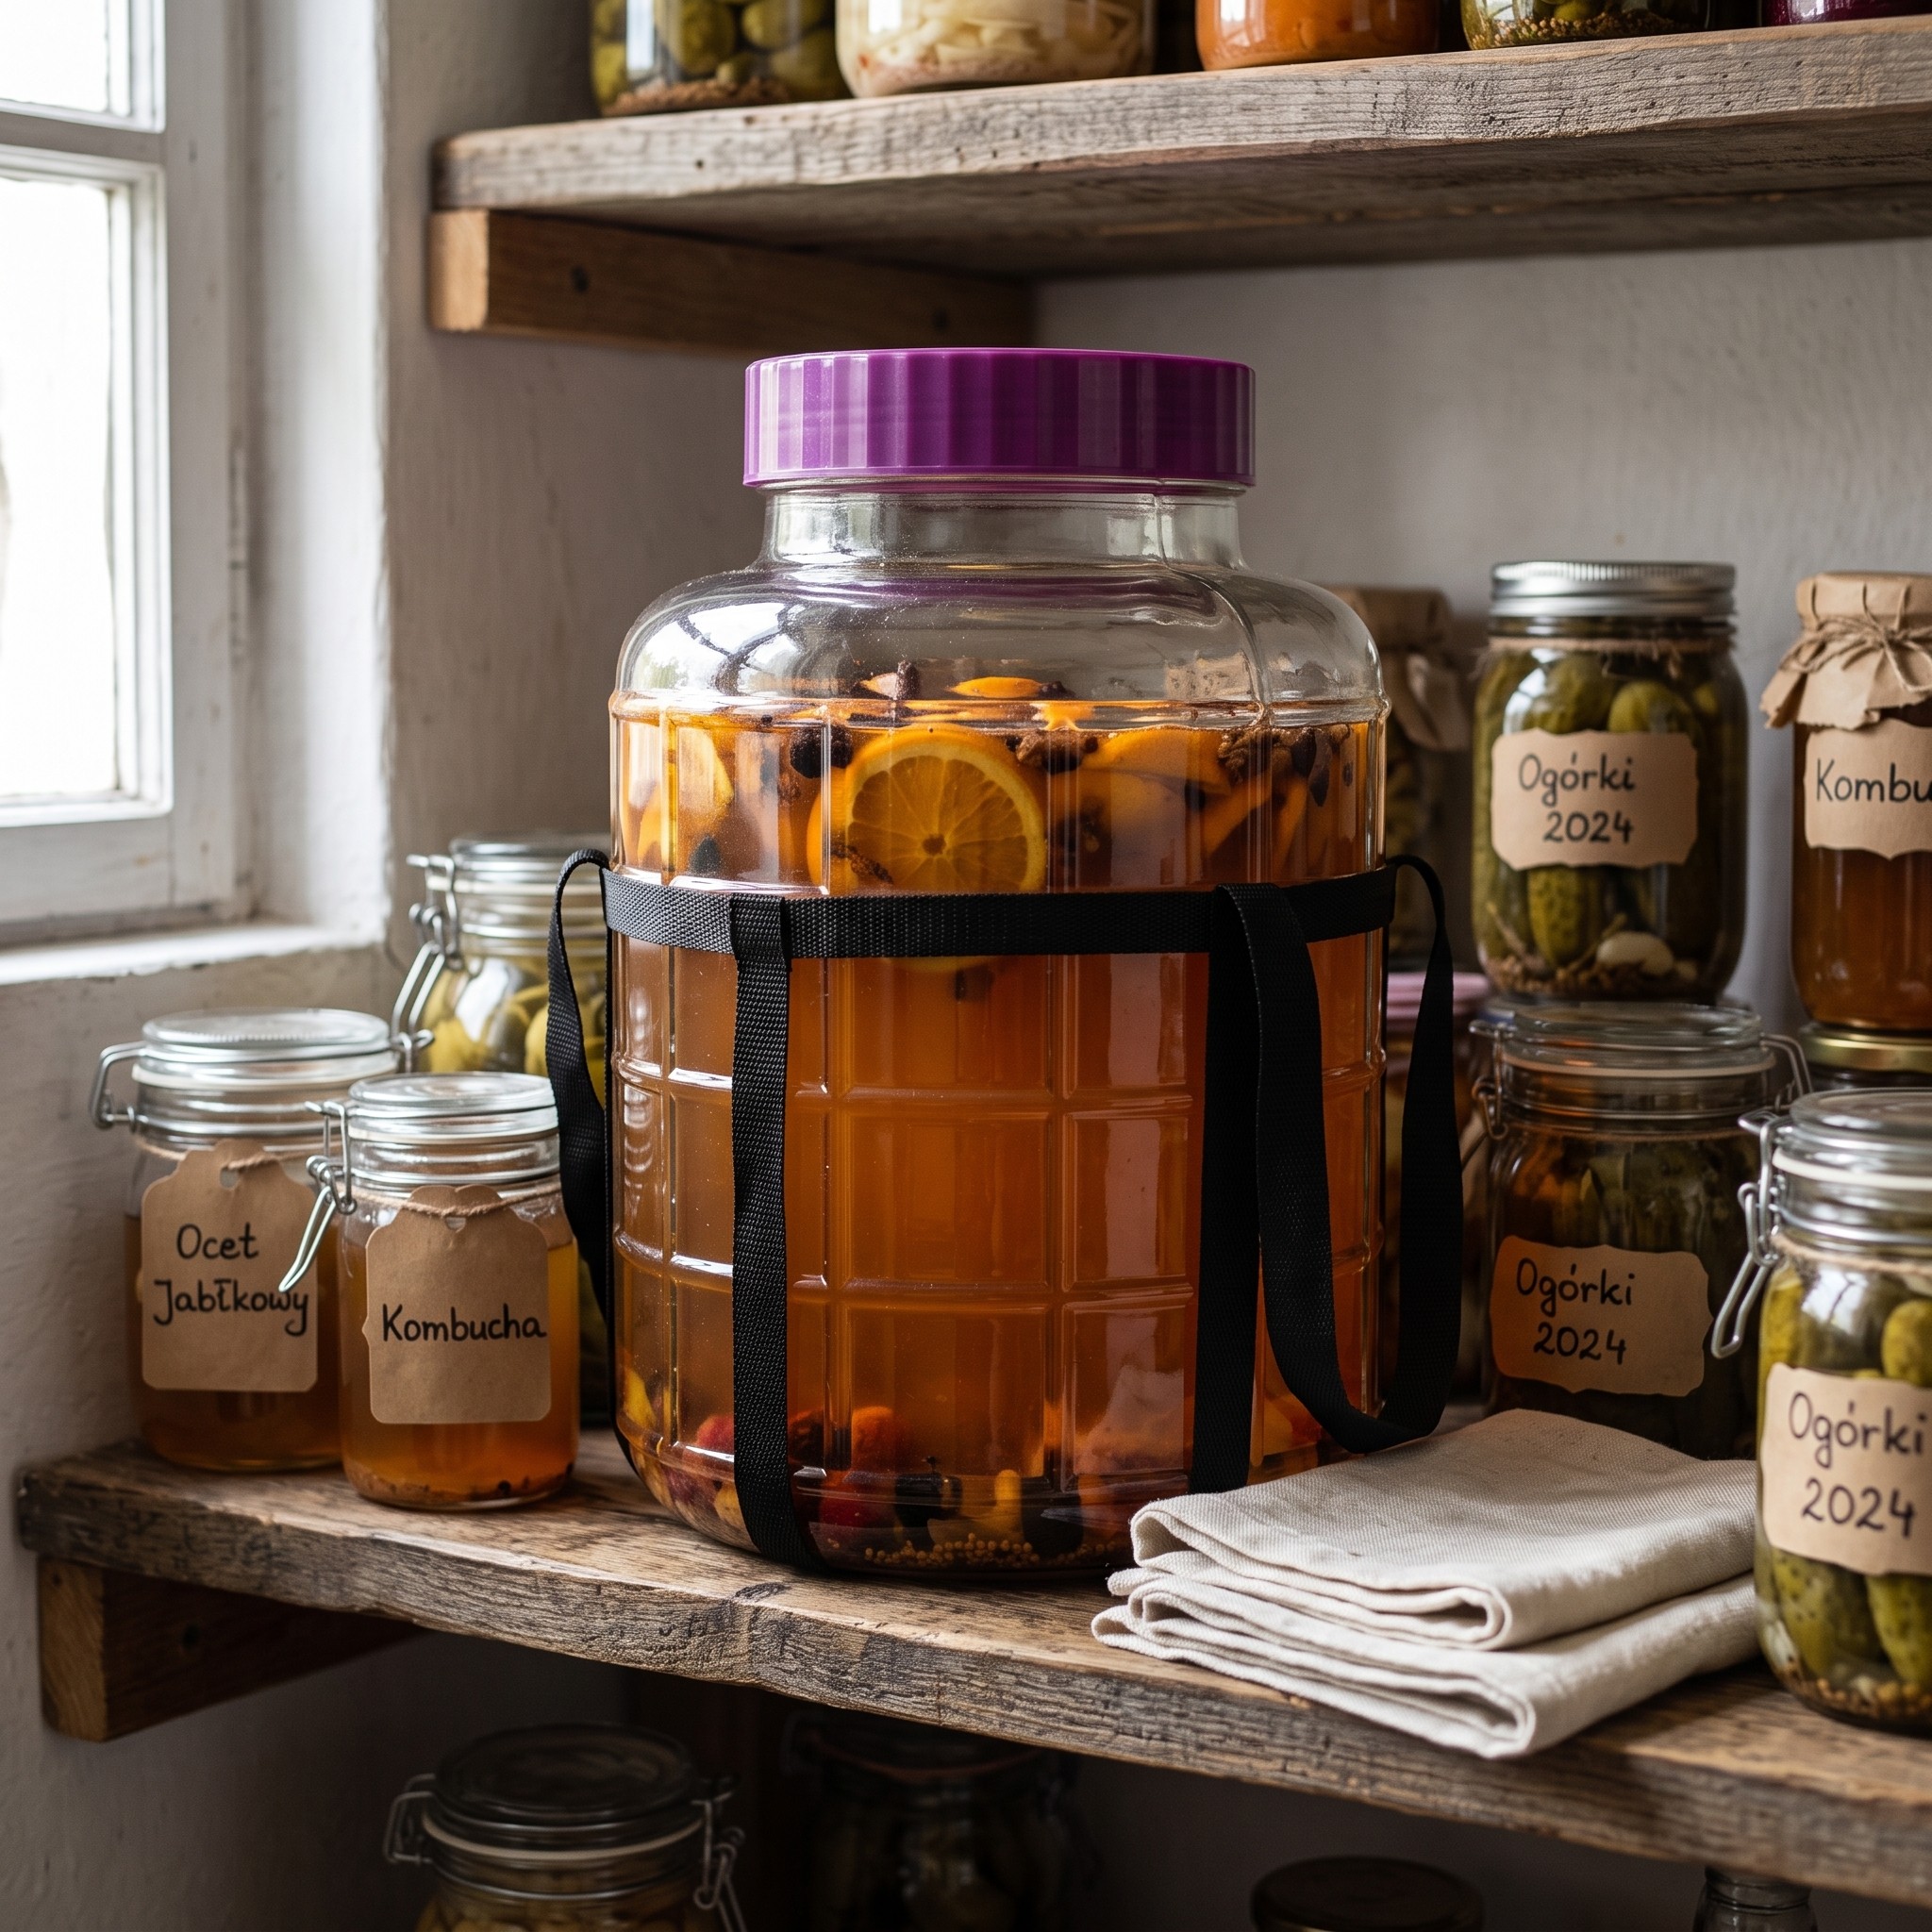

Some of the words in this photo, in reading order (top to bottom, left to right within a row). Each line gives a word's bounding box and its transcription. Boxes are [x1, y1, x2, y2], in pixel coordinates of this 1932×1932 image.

[1519, 752, 1636, 808] Ogórki
[1543, 810, 1634, 844] 2024
[176, 1222, 259, 1260] Ocet
[1516, 1257, 1636, 1318] Ogórki
[382, 1303, 548, 1342] Kombucha
[1534, 1322, 1626, 1365] 2024
[1789, 1391, 1928, 1470] Ogórki
[1801, 1476, 1916, 1539] 2024
